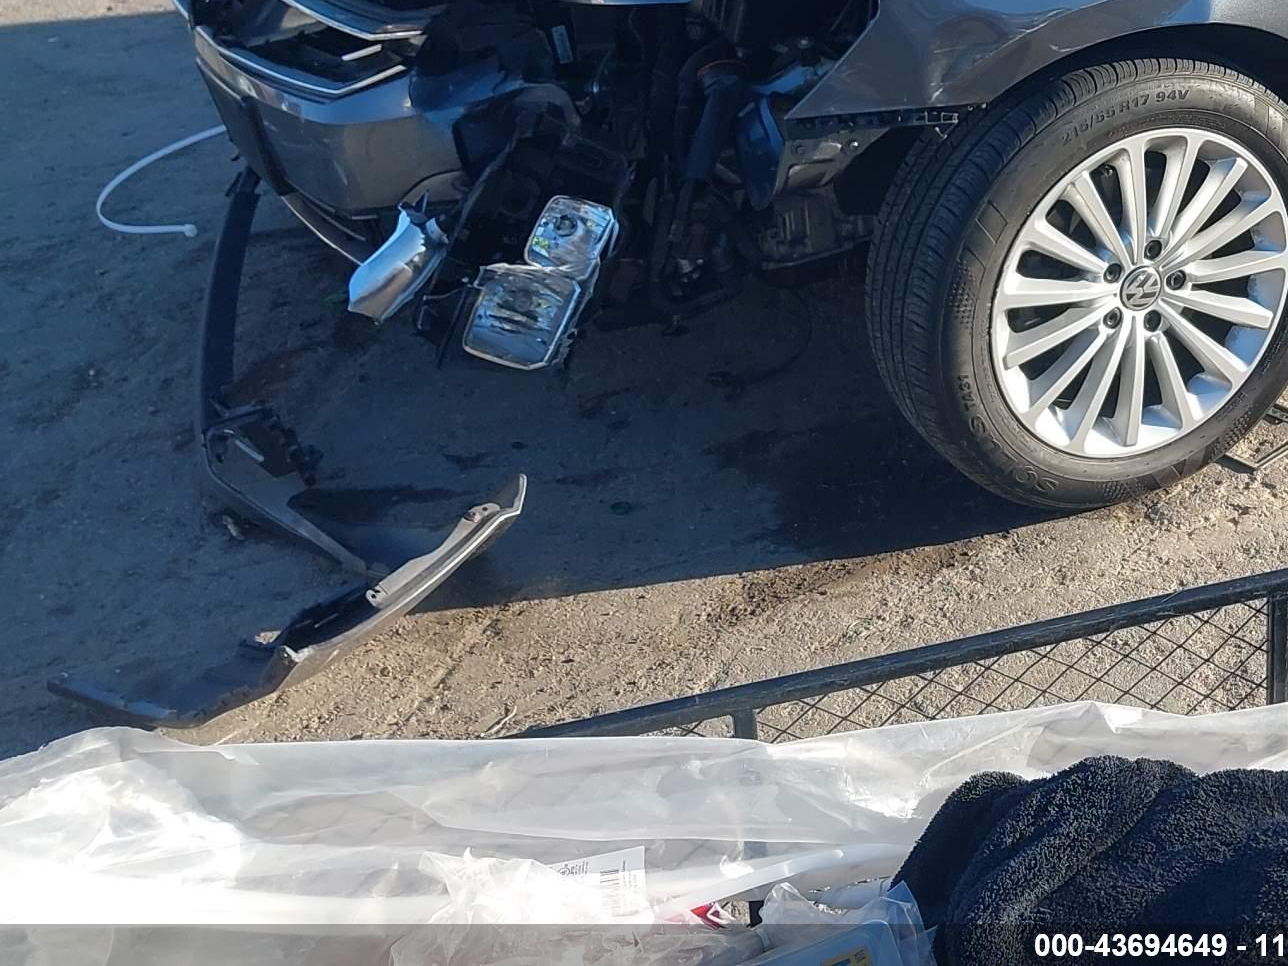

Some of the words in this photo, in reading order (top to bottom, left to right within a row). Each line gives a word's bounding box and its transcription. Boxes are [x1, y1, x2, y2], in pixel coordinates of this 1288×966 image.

[1119, 93, 1150, 113] R17
[1155, 88, 1190, 103] 94V
[957, 374, 977, 412] TA31
